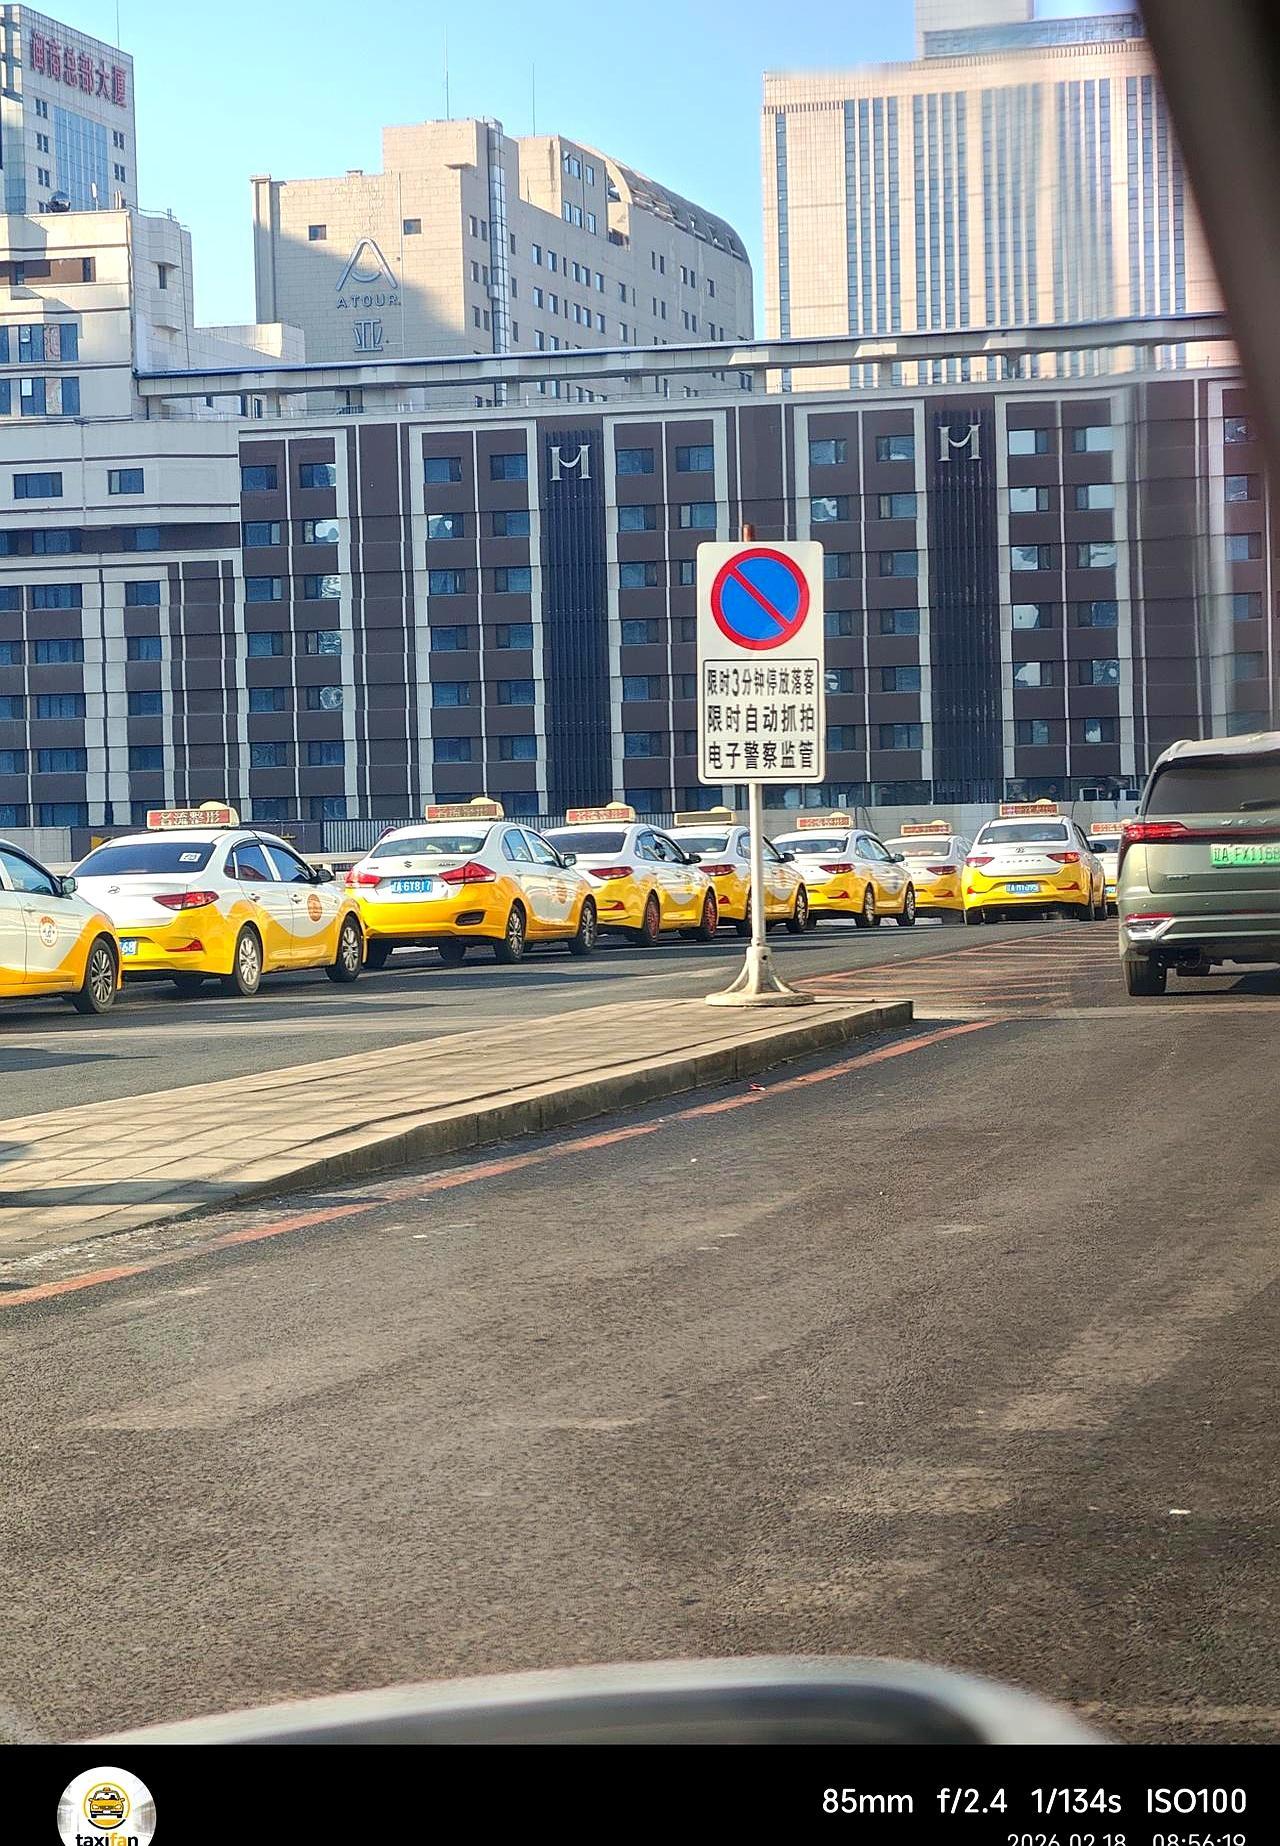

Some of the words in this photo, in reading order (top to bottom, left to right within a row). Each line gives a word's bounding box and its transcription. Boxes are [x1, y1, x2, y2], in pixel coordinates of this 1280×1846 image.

[337, 294, 399, 309] ATOUR
[707, 667, 814, 697] 限时3分钟停放落客
[707, 703, 815, 733] 限时自动抓拍
[708, 740, 814, 770] 电子警察监管
